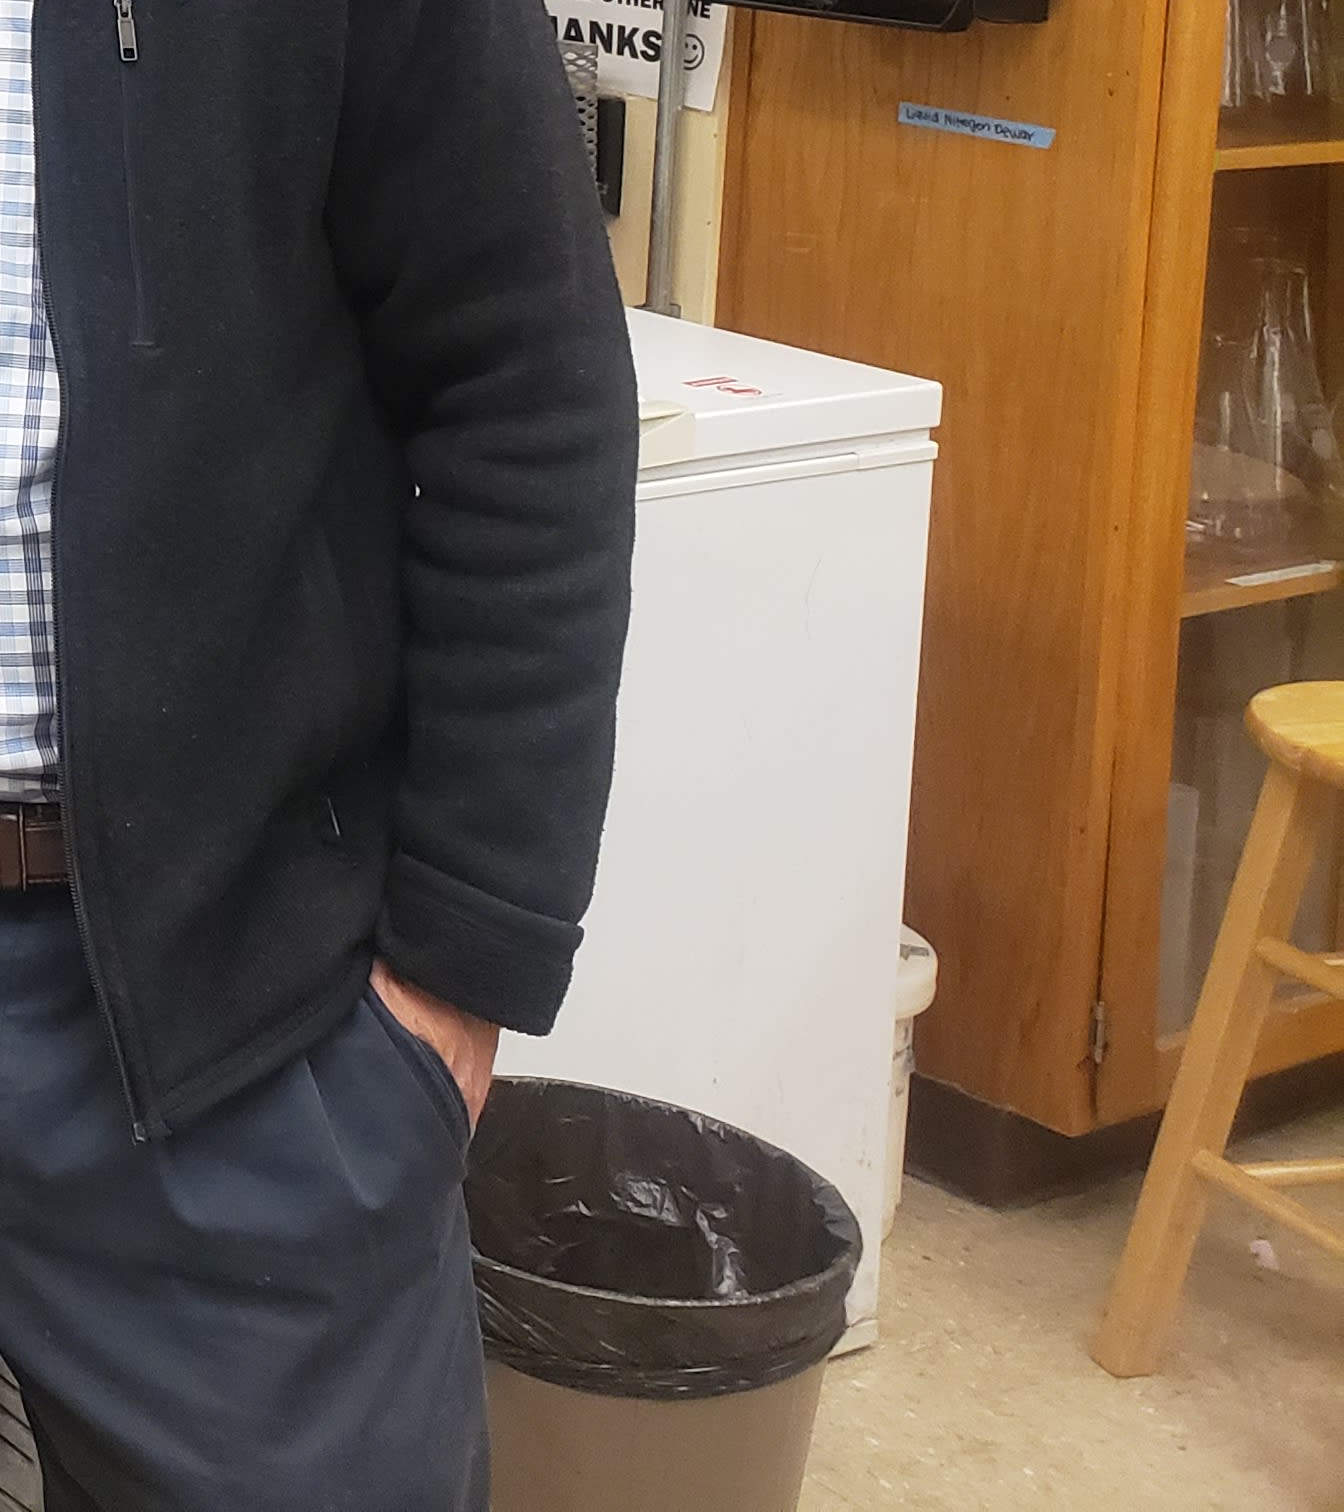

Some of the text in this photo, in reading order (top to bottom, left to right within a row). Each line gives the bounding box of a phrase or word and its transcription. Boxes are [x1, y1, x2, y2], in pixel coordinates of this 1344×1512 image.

[688, 0, 712, 19] NE
[552, 15, 662, 62] ANKS
[906, 107, 940, 123] Liquid
[994, 124, 1033, 142] Dewar
